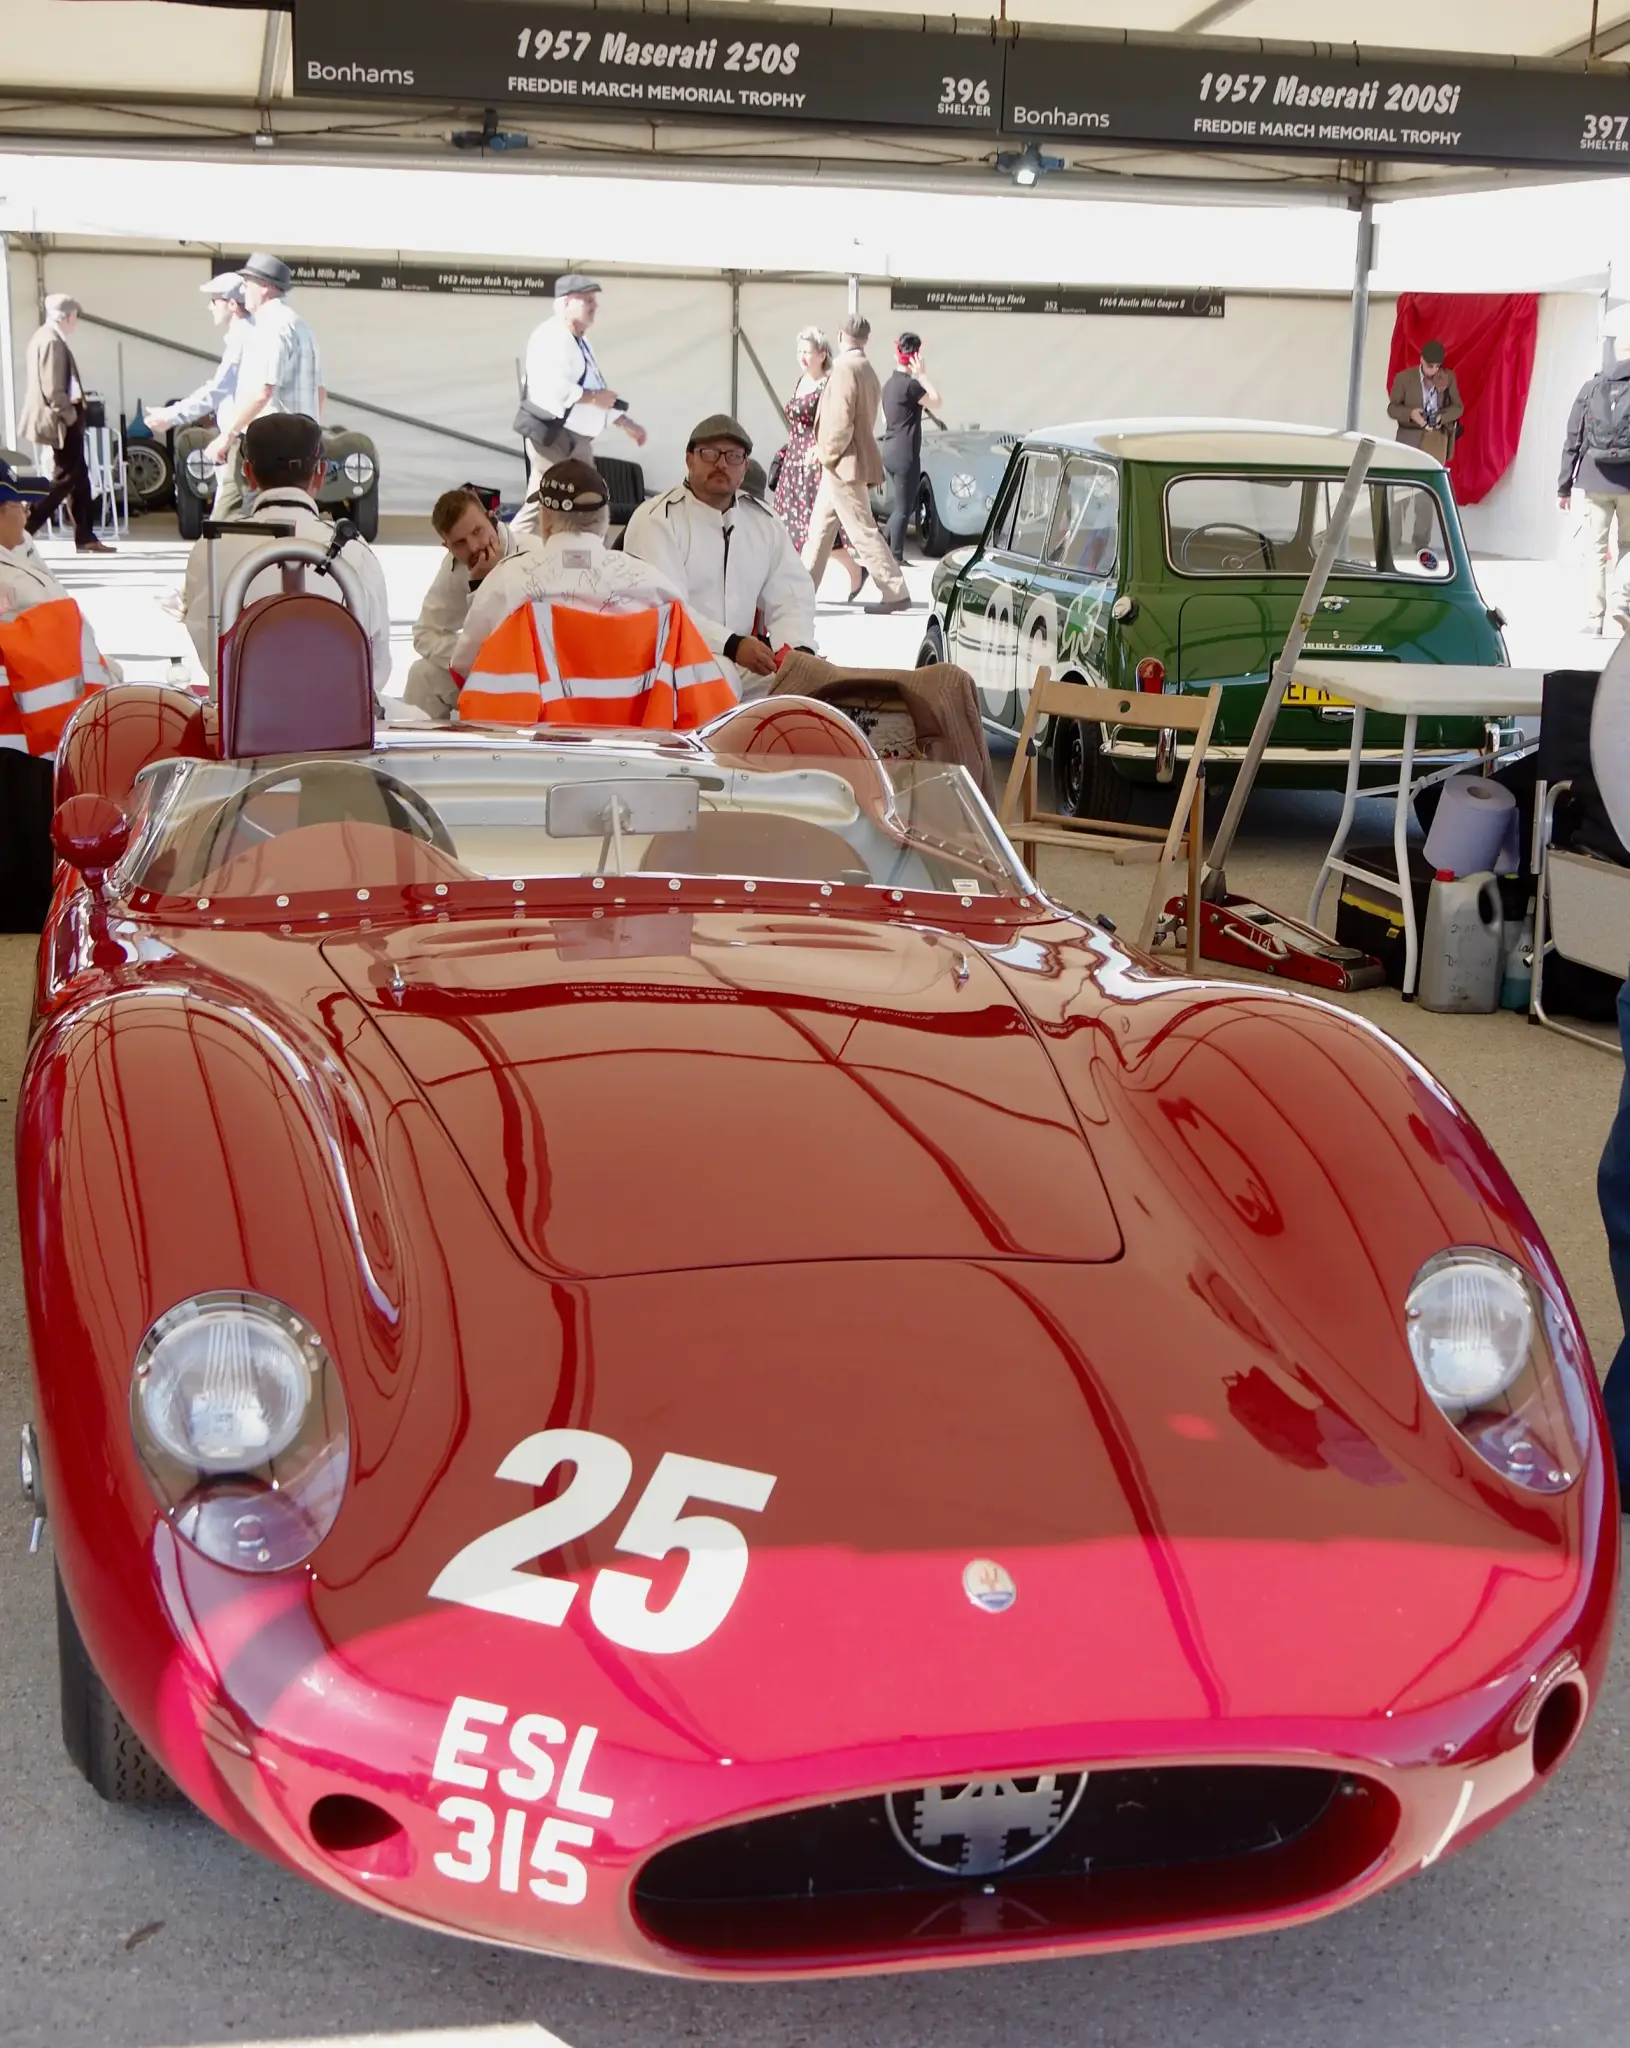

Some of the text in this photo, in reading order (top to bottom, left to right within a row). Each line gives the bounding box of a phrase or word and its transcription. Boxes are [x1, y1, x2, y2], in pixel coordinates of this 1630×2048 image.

[517, 28, 800, 75] 1957 Maserati 250S
[307, 60, 415, 85] Bonhams
[508, 76, 806, 108] FREDDIE MARCH MEMORIAL TROPHY
[940, 77, 991, 105] 396
[1199, 72, 1461, 114] 1957 Maserati 200Si
[937, 103, 991, 117] SHELTER
[1013, 106, 1110, 128] Bonhams
[1193, 118, 1462, 145] FREDDIE MARCH MEMORIAL TROPHY
[1582, 114, 1629, 140] 397
[1580, 139, 1629, 151] SHELTER
[1333, 630, 1340, 639] S
[427, 1428, 778, 1654] 25
[431, 1696, 614, 1819] ESL
[433, 1796, 595, 1906] 315
